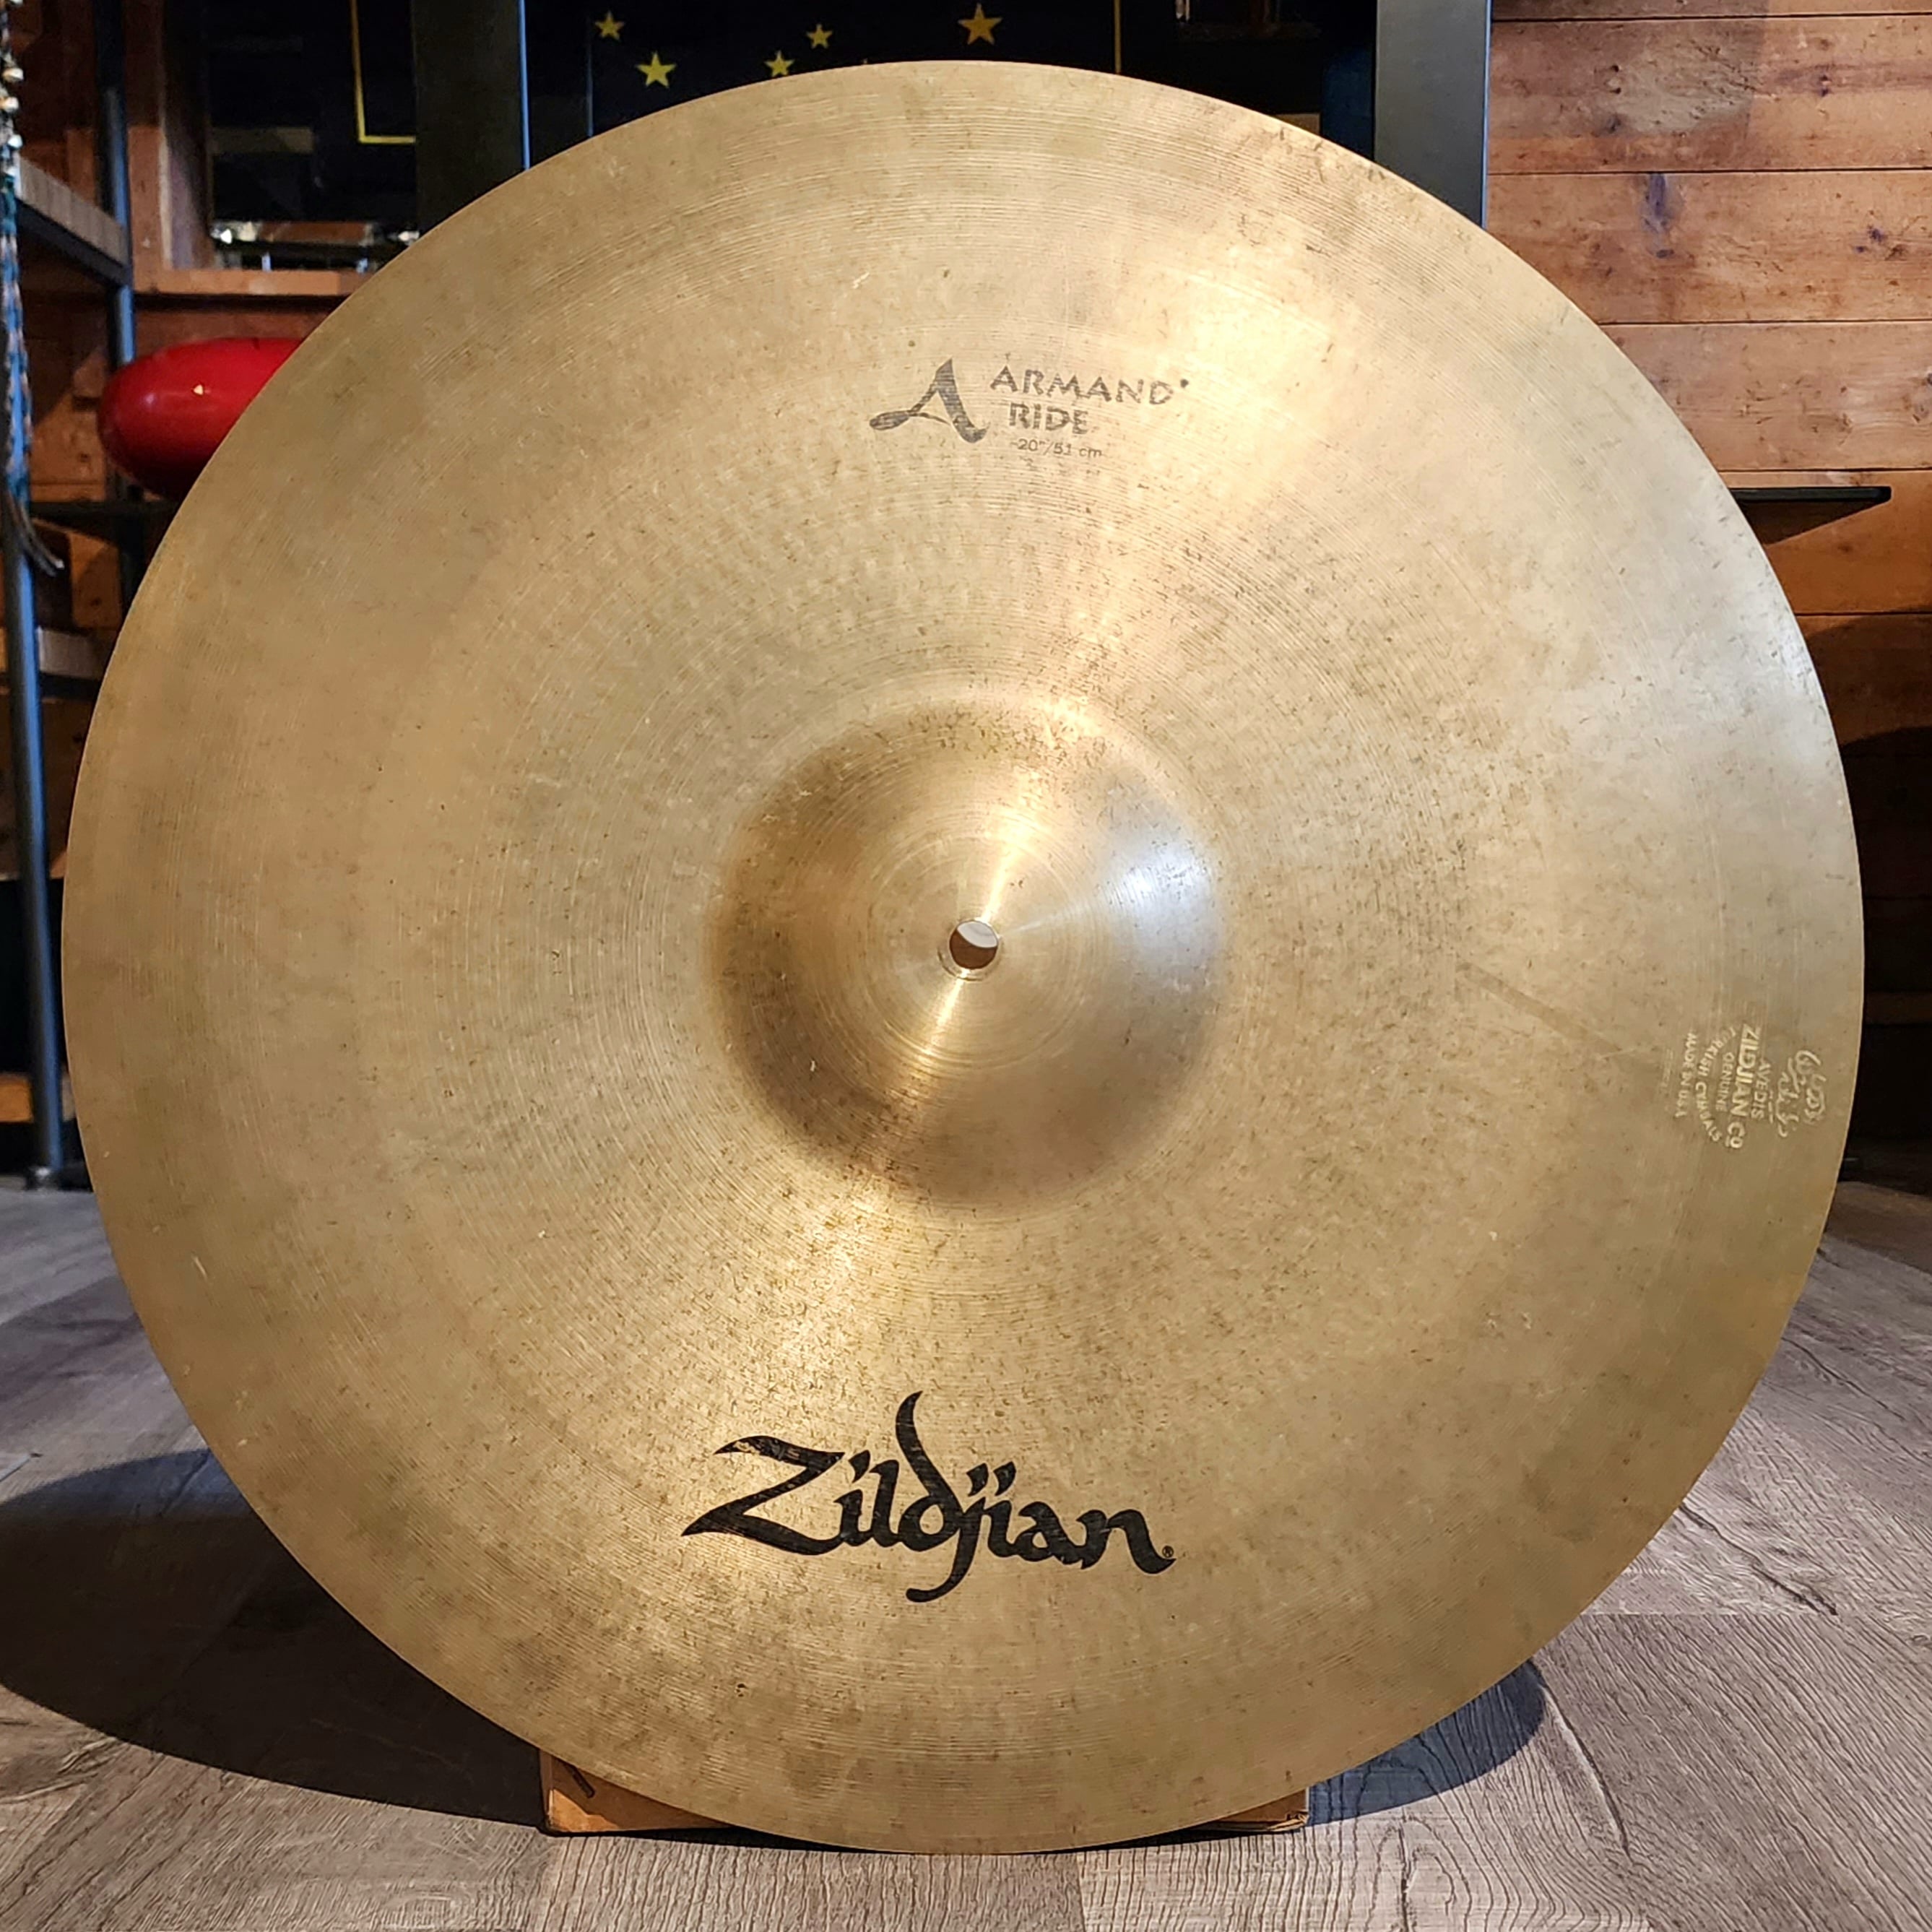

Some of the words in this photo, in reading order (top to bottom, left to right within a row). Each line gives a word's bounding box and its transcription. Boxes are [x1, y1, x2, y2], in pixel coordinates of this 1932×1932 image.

[990, 365, 1174, 404] ARMAND
[1009, 402, 1088, 435] RIDE
[1078, 447, 1103, 459] cm
[1681, 1033, 1697, 1067] MADE
[1680, 1071, 1693, 1086] IN
[1730, 1023, 1761, 1117] ZILDJIAN
[1751, 1058, 1771, 1119] AVEDIS
[1695, 1082, 1722, 1142] CYMBALS
